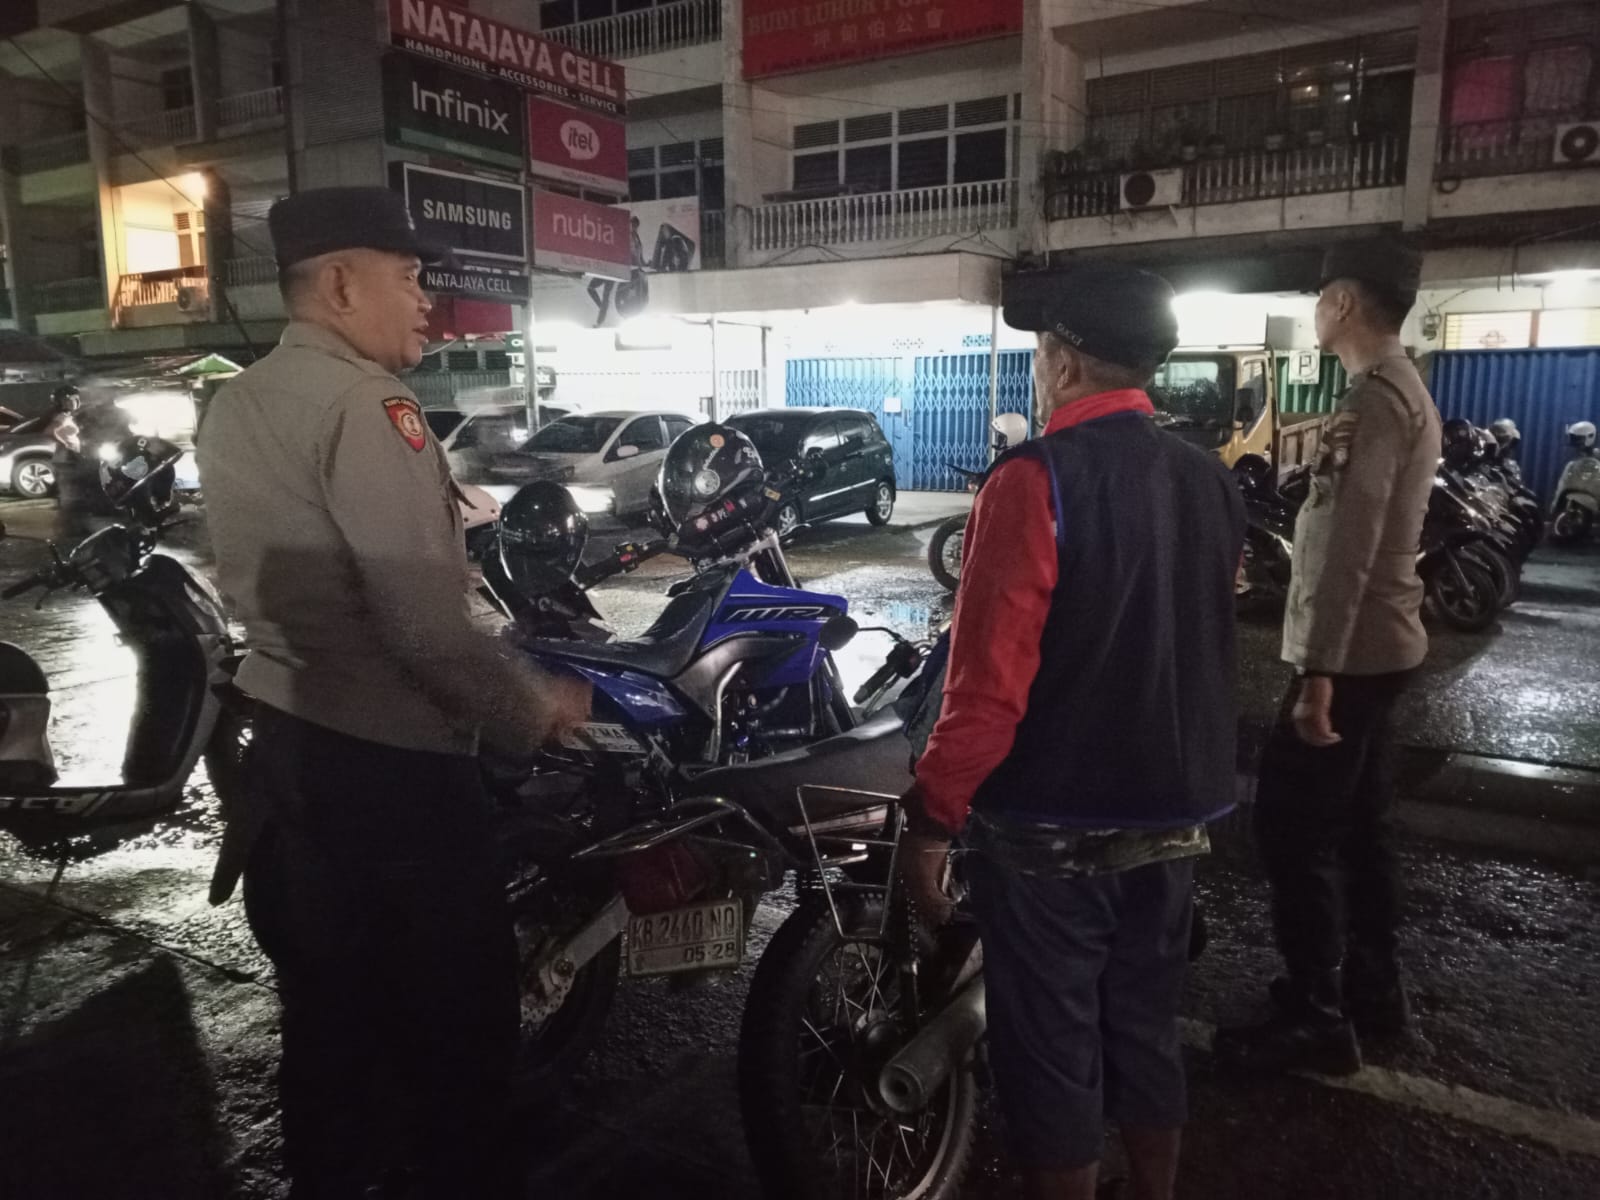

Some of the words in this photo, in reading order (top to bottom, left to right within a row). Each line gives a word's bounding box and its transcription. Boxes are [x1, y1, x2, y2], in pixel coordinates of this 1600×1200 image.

[403, 0, 555, 77] NATAJAYA
[560, 52, 618, 98] CELL
[405, 38, 488, 72] HANDPHONE
[499, 67, 569, 97] ACCESSORIES
[579, 92, 617, 113] SERVICE
[412, 81, 510, 135] Infinix
[568, 127, 593, 153] itel
[423, 198, 512, 231] SAMSUNG
[552, 213, 615, 245] nubia
[426, 271, 485, 290] NATAJAYA
[486, 278, 513, 293] CELL
[632, 917, 652, 948] KB
